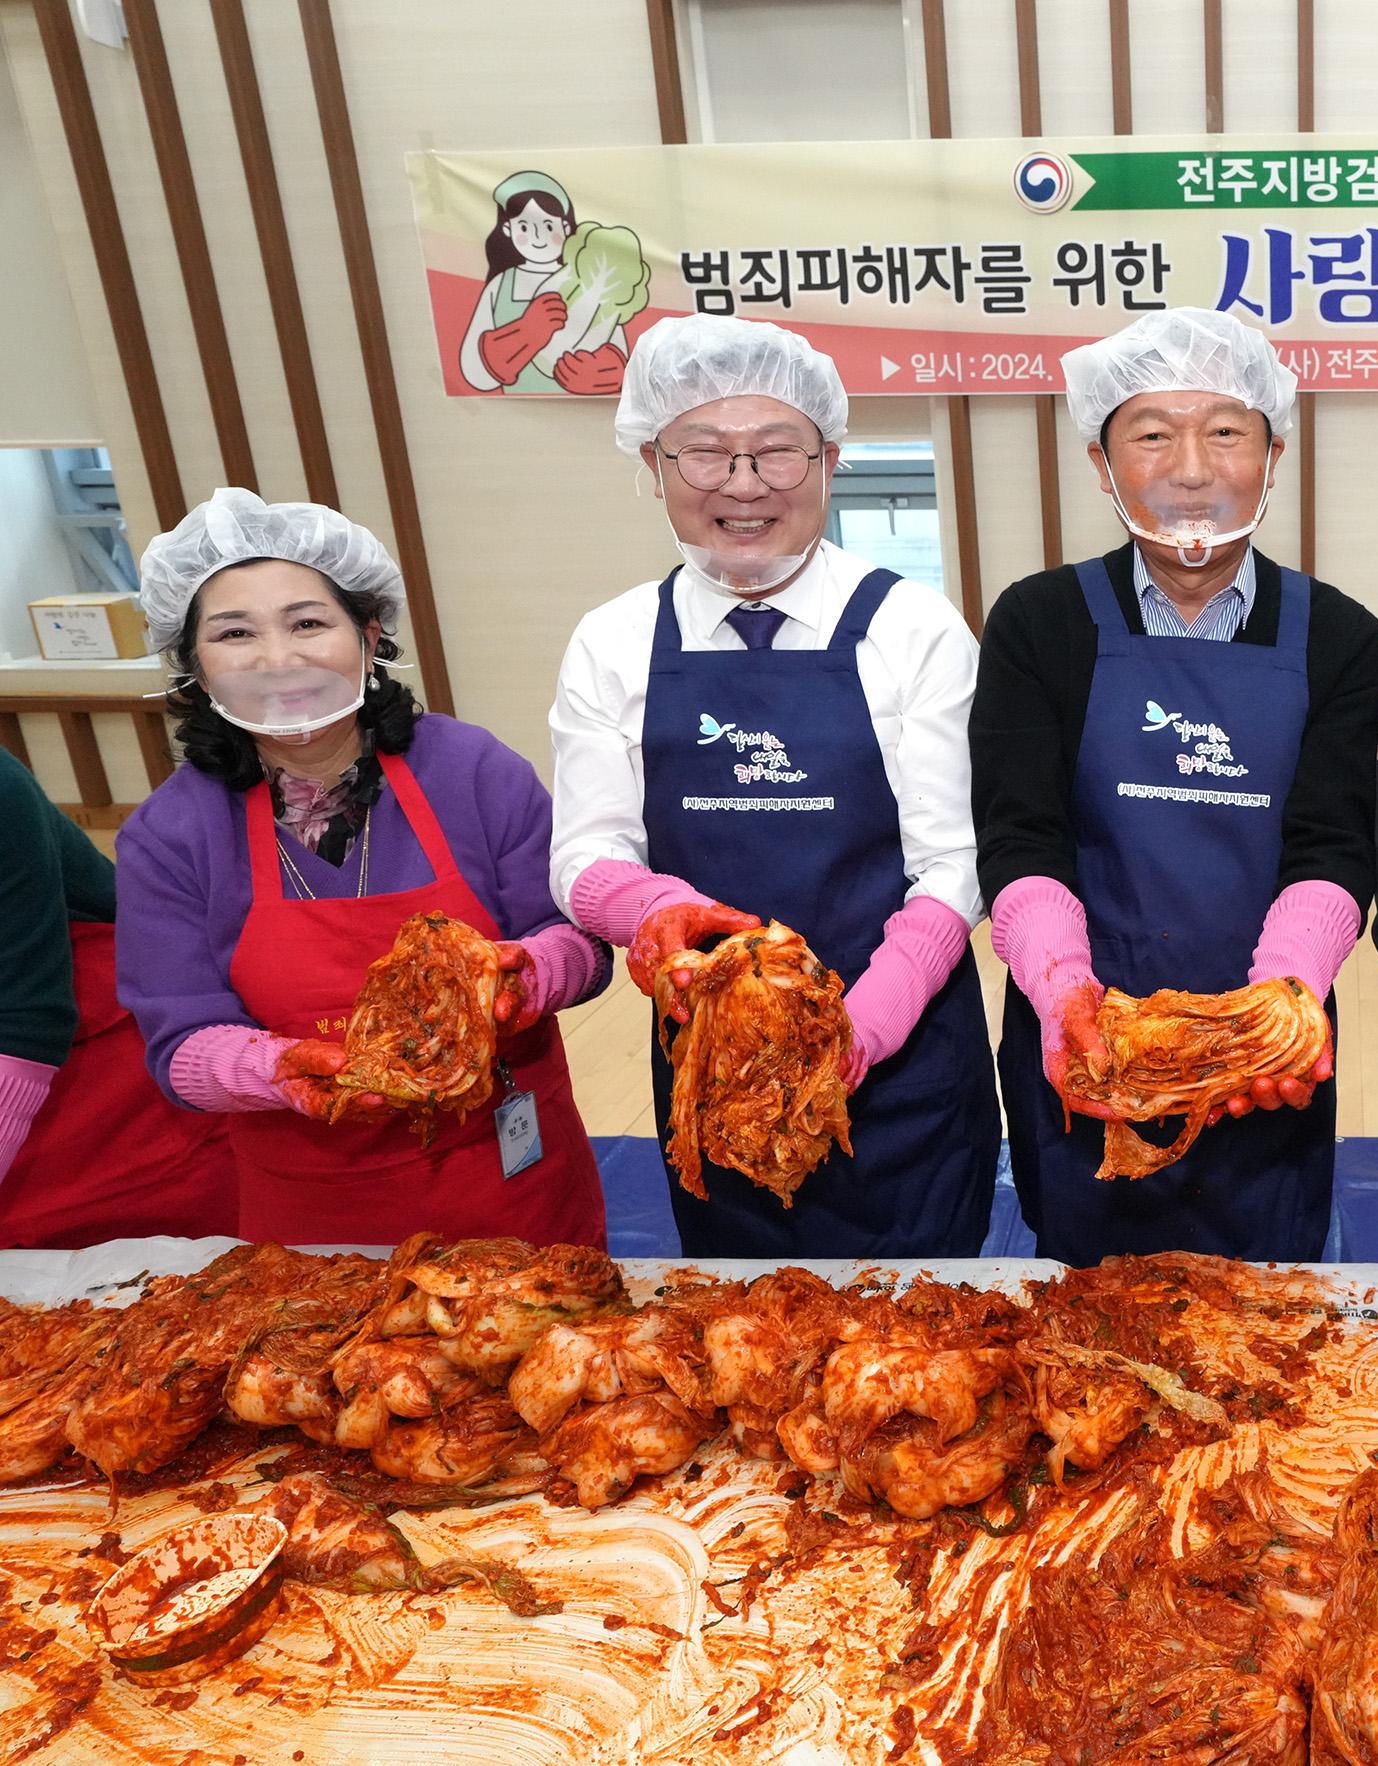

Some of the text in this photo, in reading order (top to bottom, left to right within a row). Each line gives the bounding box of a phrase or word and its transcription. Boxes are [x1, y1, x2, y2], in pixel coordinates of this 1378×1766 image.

[680, 242, 1032, 316] 범죄피해자를
[1052, 240, 1171, 311] 위한
[315, 1016, 347, 1034] 범죄
